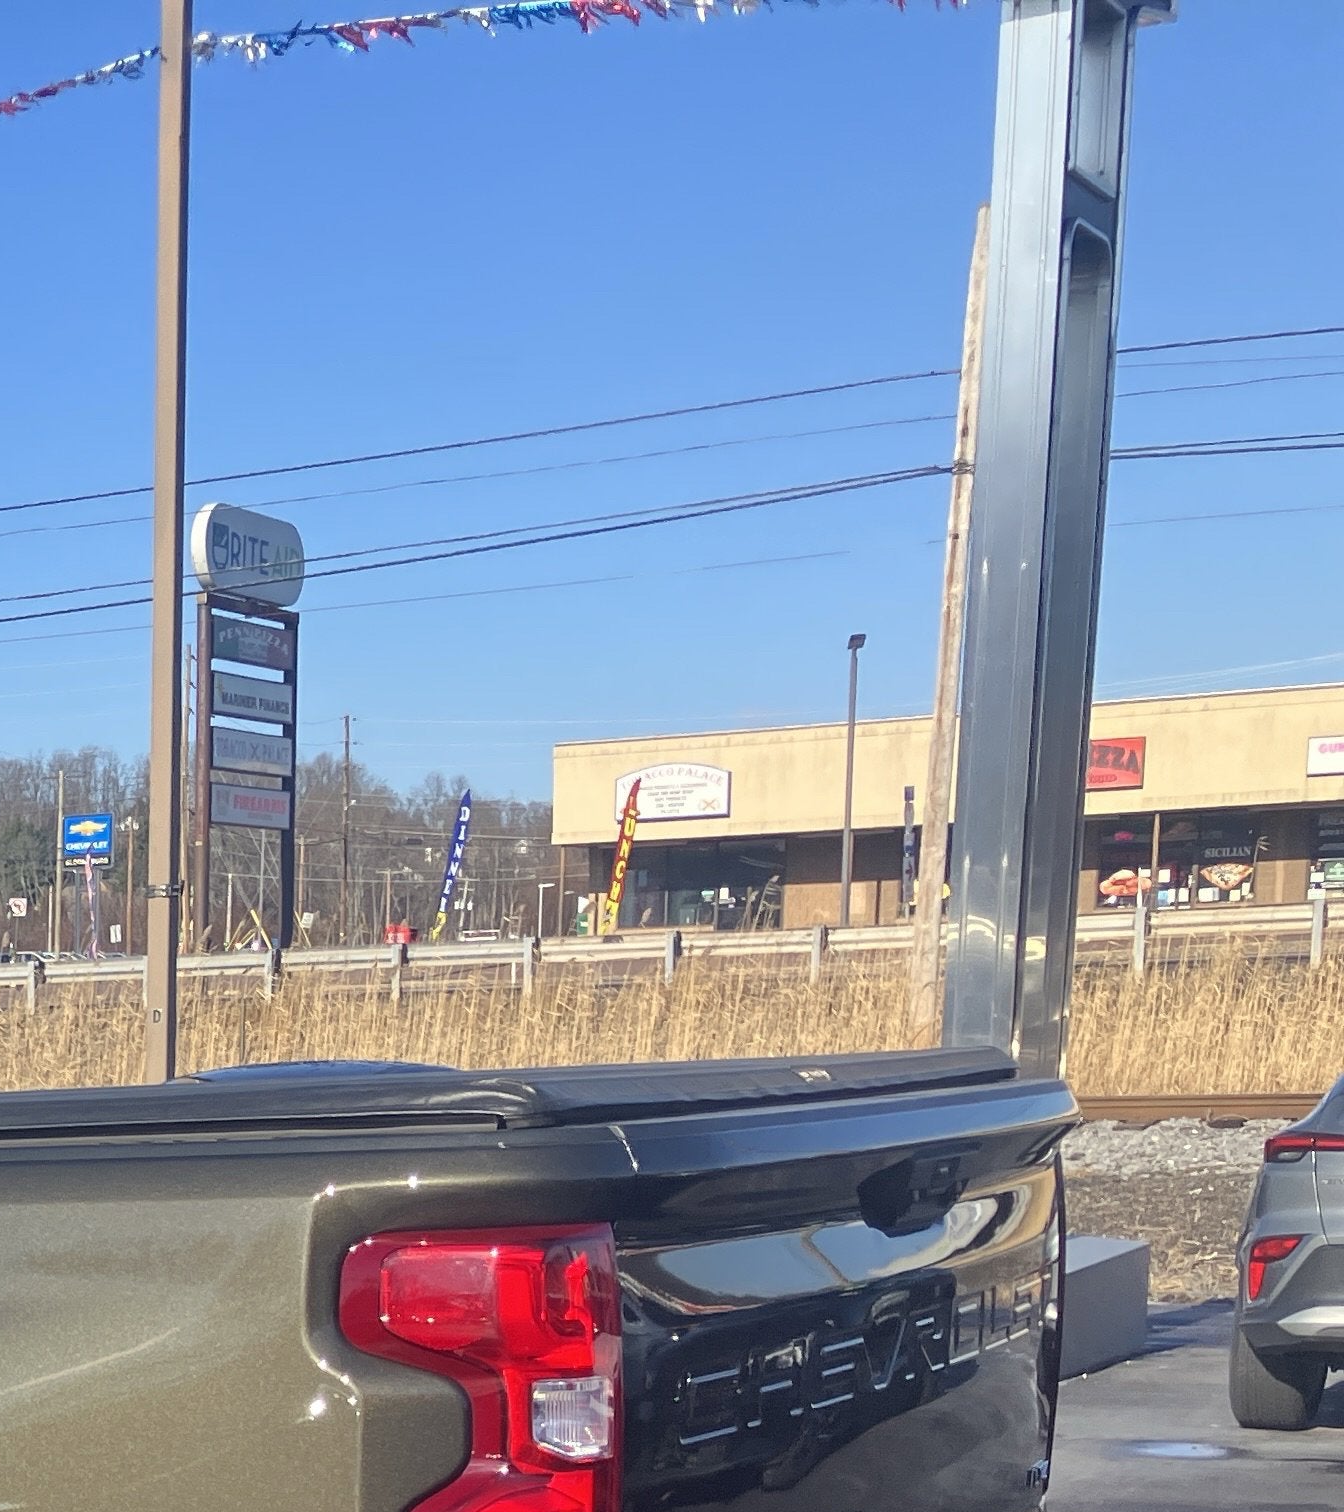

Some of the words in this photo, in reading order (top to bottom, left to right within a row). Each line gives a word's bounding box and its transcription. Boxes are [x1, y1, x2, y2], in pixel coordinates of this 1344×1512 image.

[231, 532, 270, 576] RITE
[272, 545, 301, 577] AID
[1089, 744, 1140, 774] IZZA
[65, 841, 108, 850] CHEVRLET
[1204, 846, 1252, 858] SICILIAN
[152, 1009, 161, 1023] D
[674, 1259, 1052, 1444] CHEVROLET
